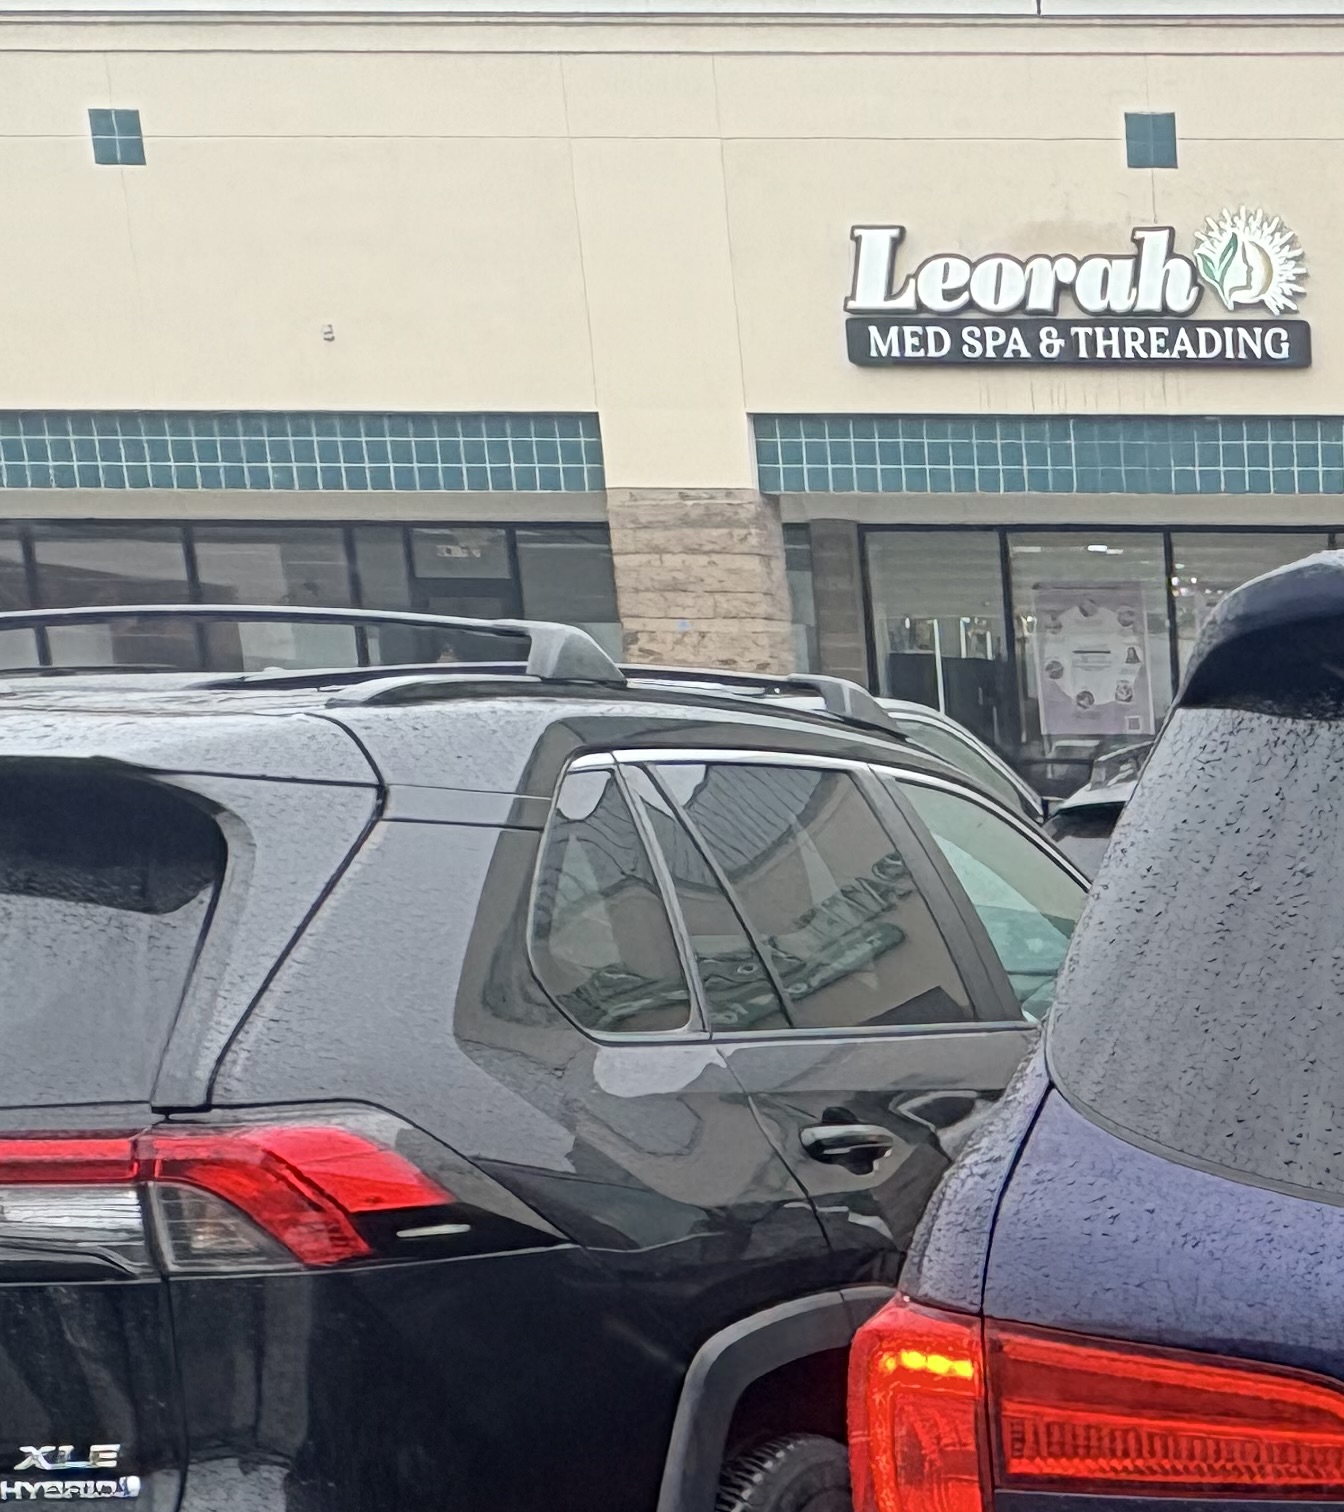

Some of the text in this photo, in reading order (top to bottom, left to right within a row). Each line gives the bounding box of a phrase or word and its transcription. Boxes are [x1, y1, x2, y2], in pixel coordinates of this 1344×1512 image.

[845, 226, 1201, 315] Leorah
[867, 325, 1290, 360] MED SPA & THREADING
[14, 1444, 120, 1470] XLE
[0, 1480, 118, 1500] HYBRID
